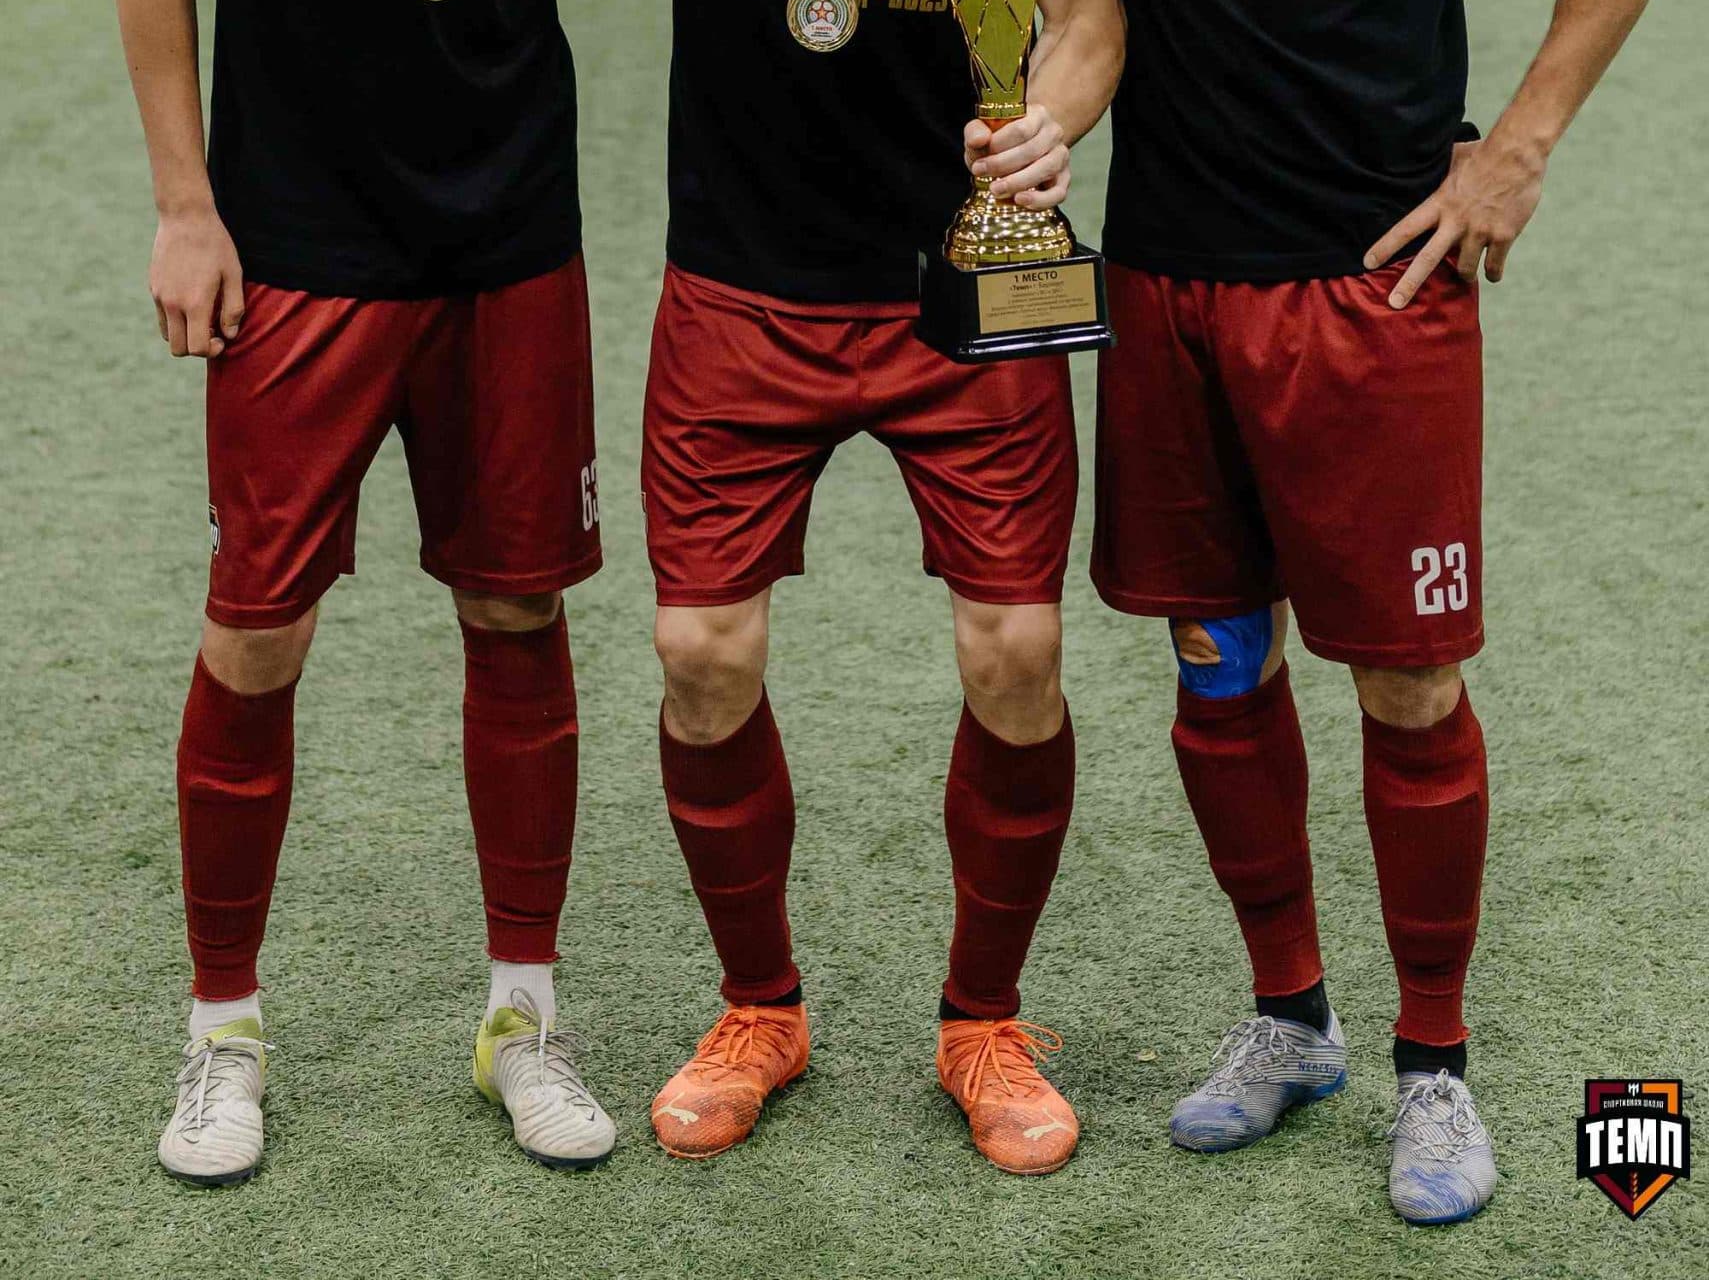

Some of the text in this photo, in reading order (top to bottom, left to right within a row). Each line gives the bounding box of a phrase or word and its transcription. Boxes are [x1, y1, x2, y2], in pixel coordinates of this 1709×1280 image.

[1014, 271, 1058, 283] 1 МЕСТО
[1411, 542, 1468, 616] 23
